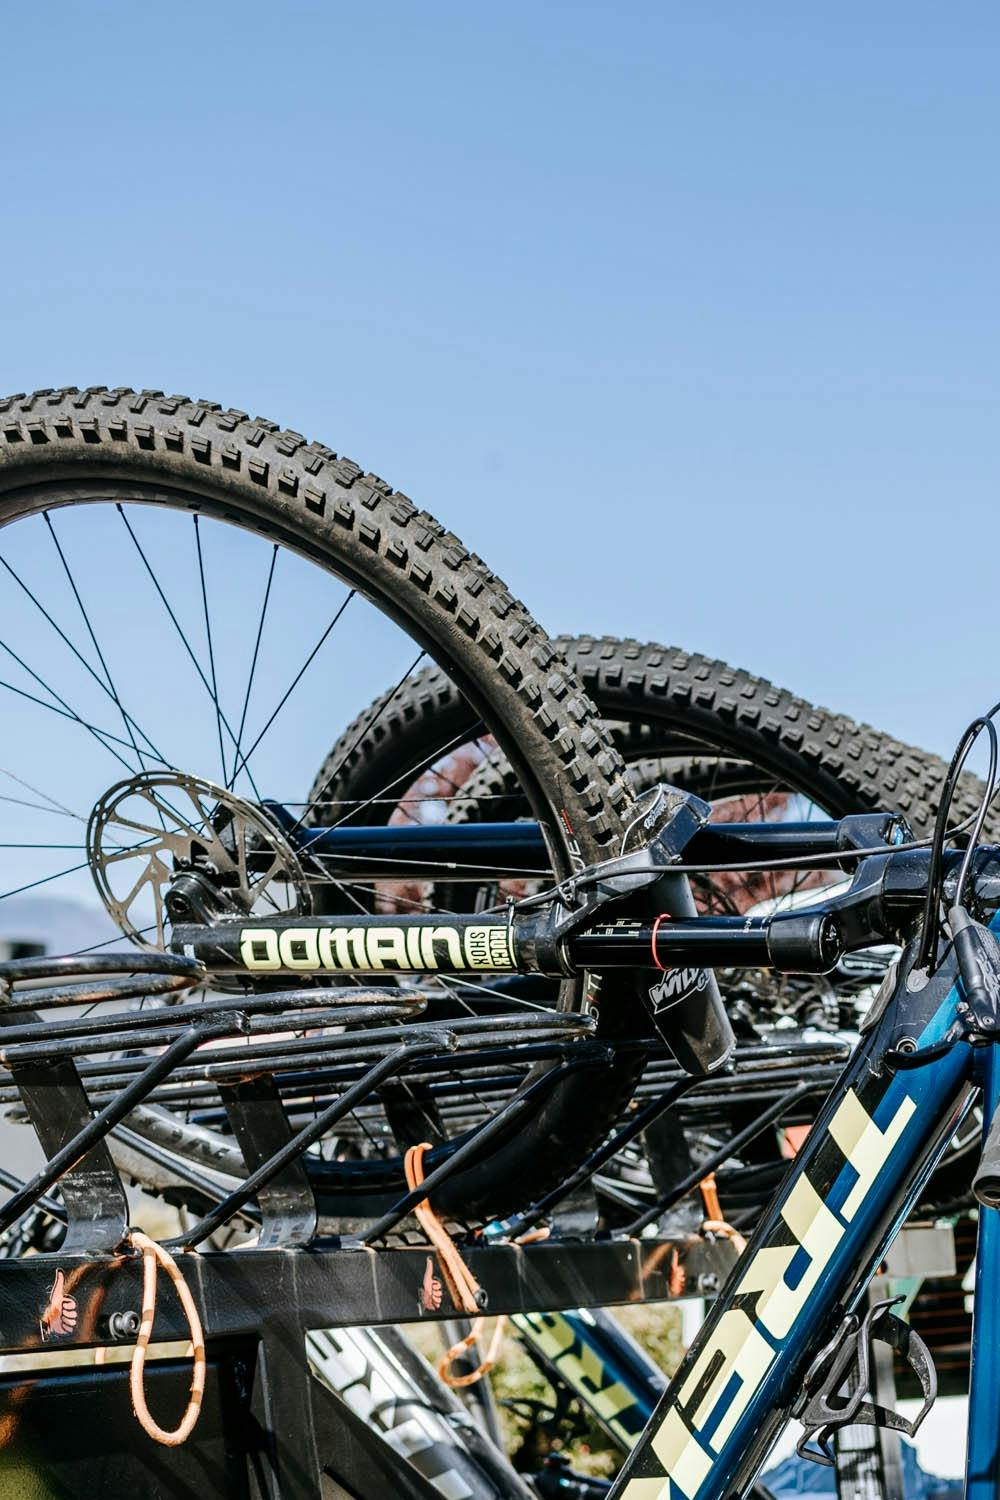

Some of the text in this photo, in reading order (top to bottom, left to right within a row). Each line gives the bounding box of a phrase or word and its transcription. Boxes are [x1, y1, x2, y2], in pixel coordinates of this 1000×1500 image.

[239, 925, 466, 971] DOMAIN
[469, 931, 490, 966] SHOX
[488, 926, 513, 969] ROCK
